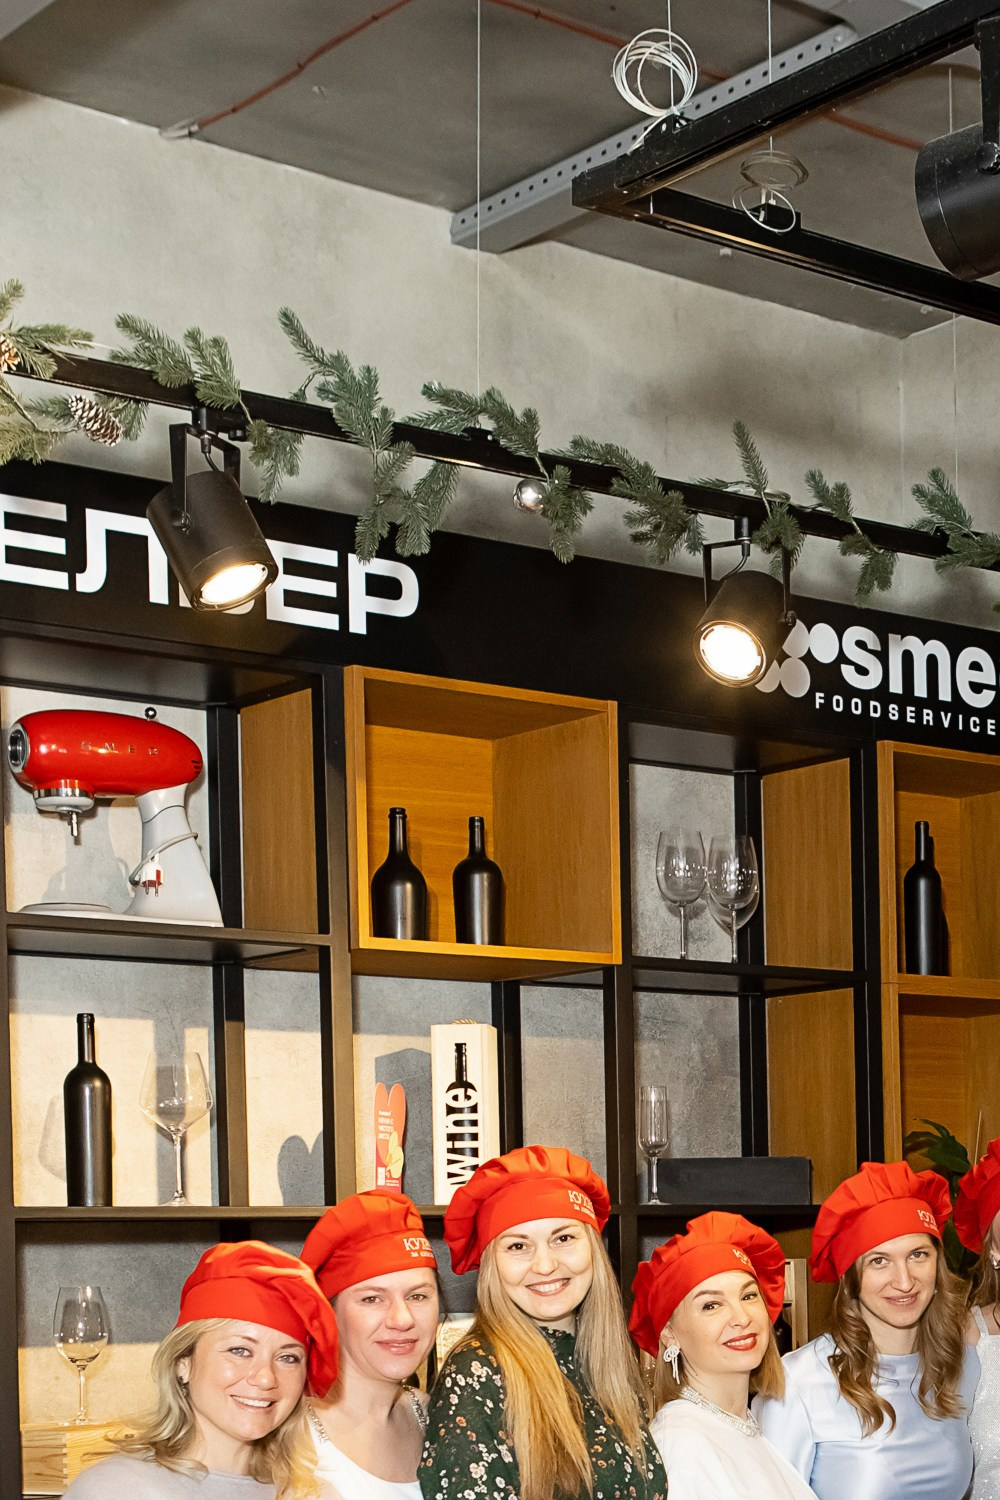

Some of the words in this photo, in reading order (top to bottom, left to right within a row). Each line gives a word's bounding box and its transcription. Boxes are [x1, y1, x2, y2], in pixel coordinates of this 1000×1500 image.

[0, 493, 419, 635] ЕЛЕР
[815, 692, 996, 736] FOODSERVICE
[445, 1087, 479, 1187] wine
